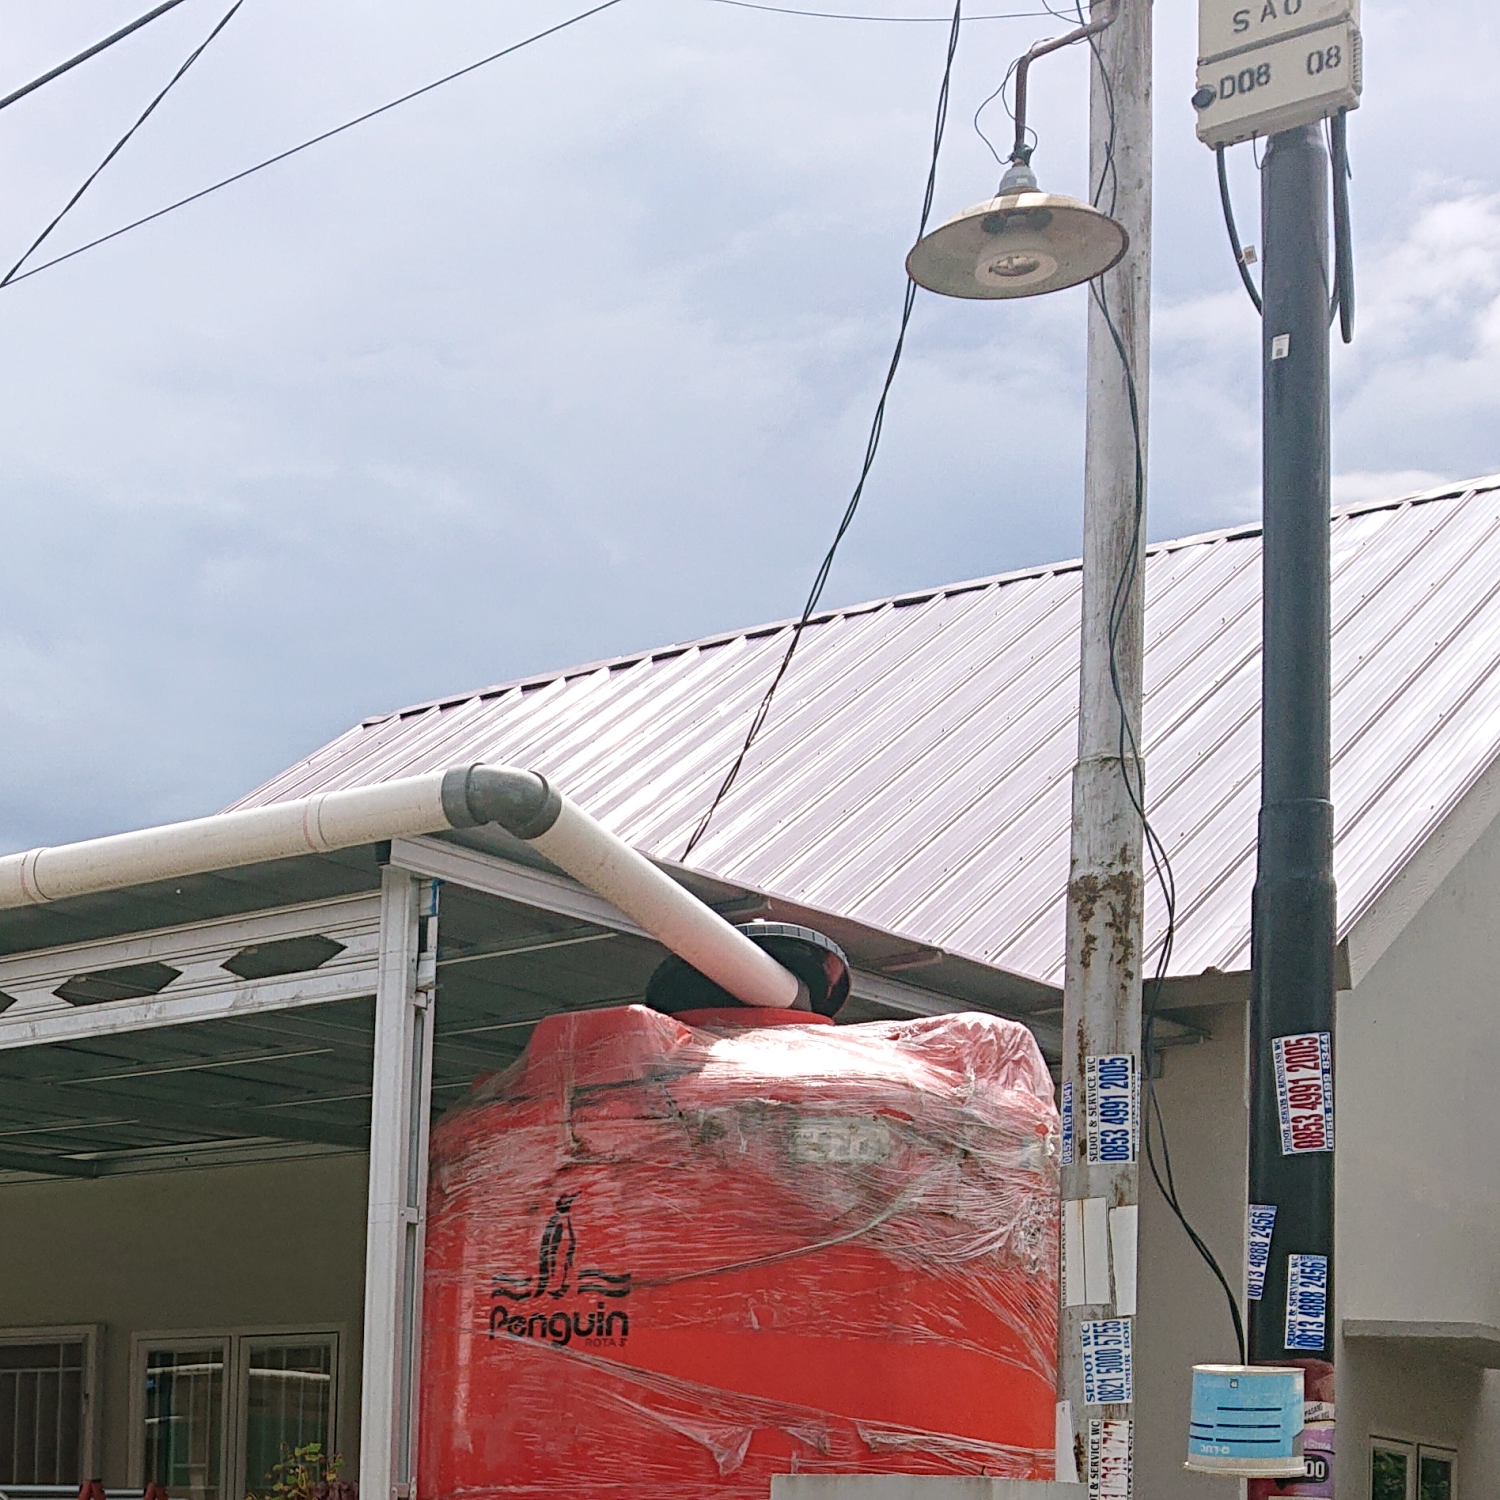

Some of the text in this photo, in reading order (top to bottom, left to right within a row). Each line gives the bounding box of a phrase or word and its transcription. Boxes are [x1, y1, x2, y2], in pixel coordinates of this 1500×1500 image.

[1306, 45, 1342, 76] 08
[1273, 1038, 1281, 1051] WC
[1087, 1057, 1098, 1162] SEDOT & SERVICE WC
[1099, 1057, 1129, 1161] 0853 4991 2005
[1284, 1037, 1326, 1150] 0853 4991 2005
[1063, 1083, 1072, 1164] 0852 7107 7041
[1250, 1212, 1274, 1238] 2456
[1249, 1242, 1269, 1268] 4888
[1247, 1270, 1264, 1297] 0813
[1299, 1262, 1326, 1288] 2456
[1287, 1256, 1299, 1347] SEDOT & SERVICE WC
[1298, 1291, 1326, 1318] 4888
[489, 1302, 629, 1345] Penguin
[1297, 1321, 1324, 1348] 0813
[1081, 1323, 1095, 1402] SEDOT WC
[1092, 1321, 1125, 1402] 0821 5000 5755
[1091, 1420, 1100, 1436] WC
[1090, 1438, 1099, 1480] SERVICE
